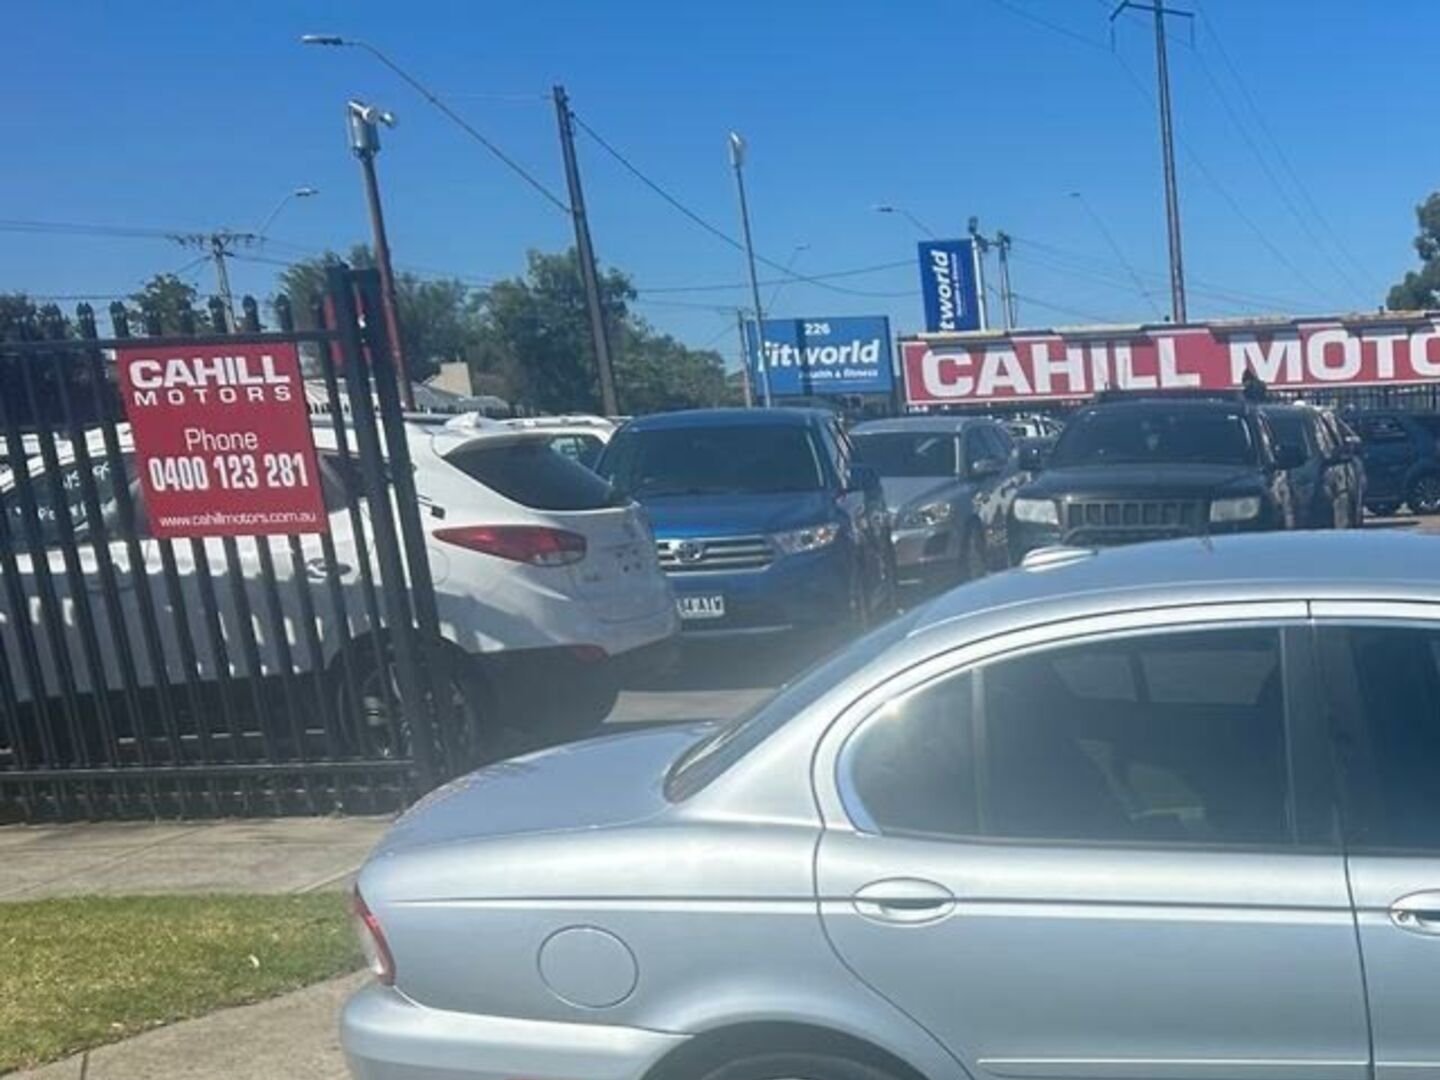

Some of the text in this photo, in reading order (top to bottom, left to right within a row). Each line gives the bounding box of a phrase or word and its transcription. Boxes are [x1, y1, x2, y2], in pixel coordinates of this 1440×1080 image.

[129, 355, 291, 389] CAHILL
[921, 337, 1200, 397] CAHILL
[133, 385, 291, 406] MOTORS
[184, 428, 259, 451] Phone
[148, 456, 210, 492] 0400
[213, 454, 259, 489] 123
[264, 453, 309, 487] 281
[159, 512, 317, 527] www.cahillmotors.com.au
